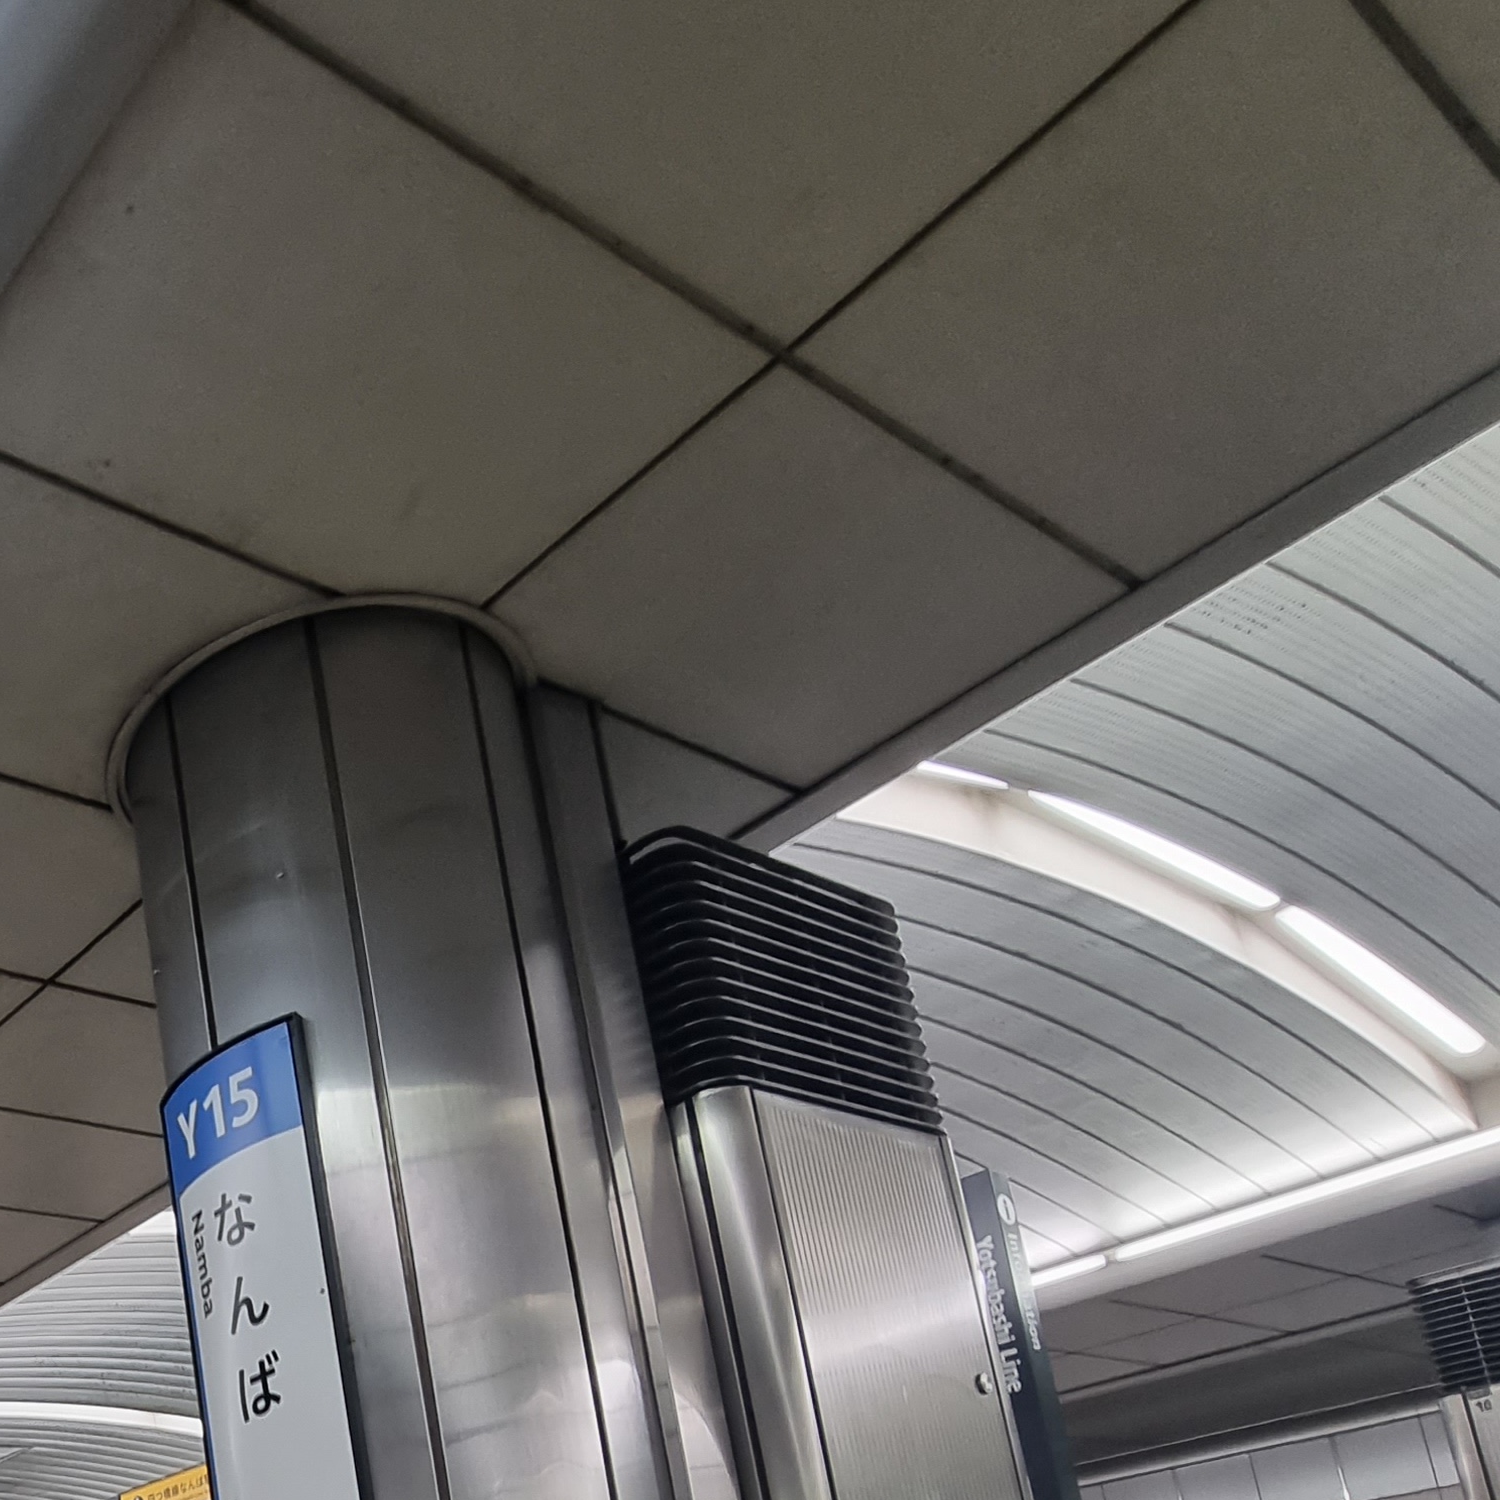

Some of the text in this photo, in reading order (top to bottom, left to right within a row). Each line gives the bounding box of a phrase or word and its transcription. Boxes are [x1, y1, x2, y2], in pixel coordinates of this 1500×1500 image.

[177, 1066, 259, 1159] Y15
[191, 1209, 214, 1319] Namba
[214, 1192, 281, 1423] なんば
